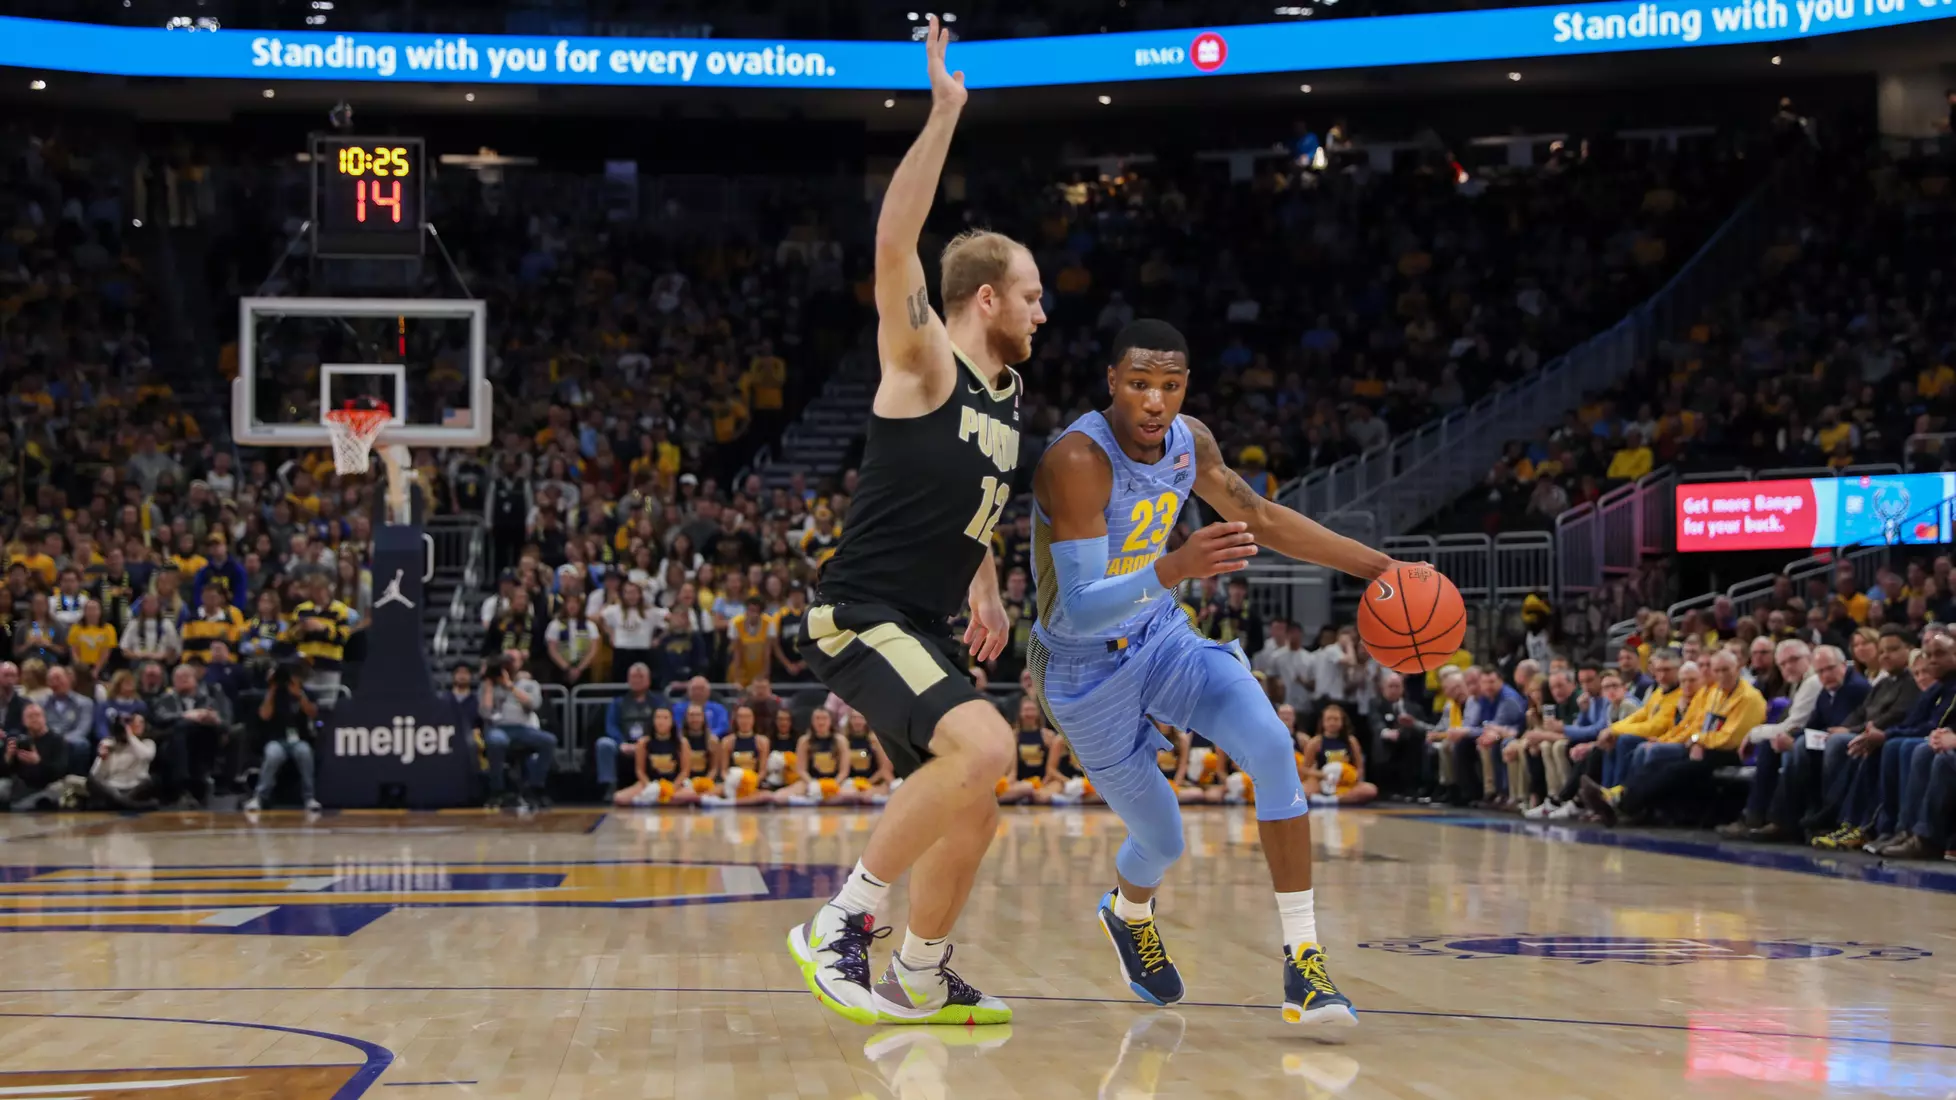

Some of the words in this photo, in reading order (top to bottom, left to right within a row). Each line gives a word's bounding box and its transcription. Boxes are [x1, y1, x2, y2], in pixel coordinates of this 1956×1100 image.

[1553, 3, 1702, 42] Standing
[1712, 0, 1788, 32] with
[1796, 0, 1855, 33] you
[252, 35, 397, 76] Standing
[405, 38, 478, 70] with
[487, 46, 547, 78] you
[555, 40, 600, 73] for
[609, 49, 698, 81] every
[706, 44, 836, 76] ovation.
[1135, 46, 1185, 67] BMO
[339, 146, 409, 177] 10:25
[357, 180, 401, 223] 14
[964, 476, 1010, 547] 12
[1121, 491, 1178, 553] 23
[1683, 497, 1709, 514] Get
[1712, 498, 1751, 513] more
[1683, 517, 1705, 536] for
[1707, 519, 1742, 539] your
[334, 716, 456, 764] meijer
